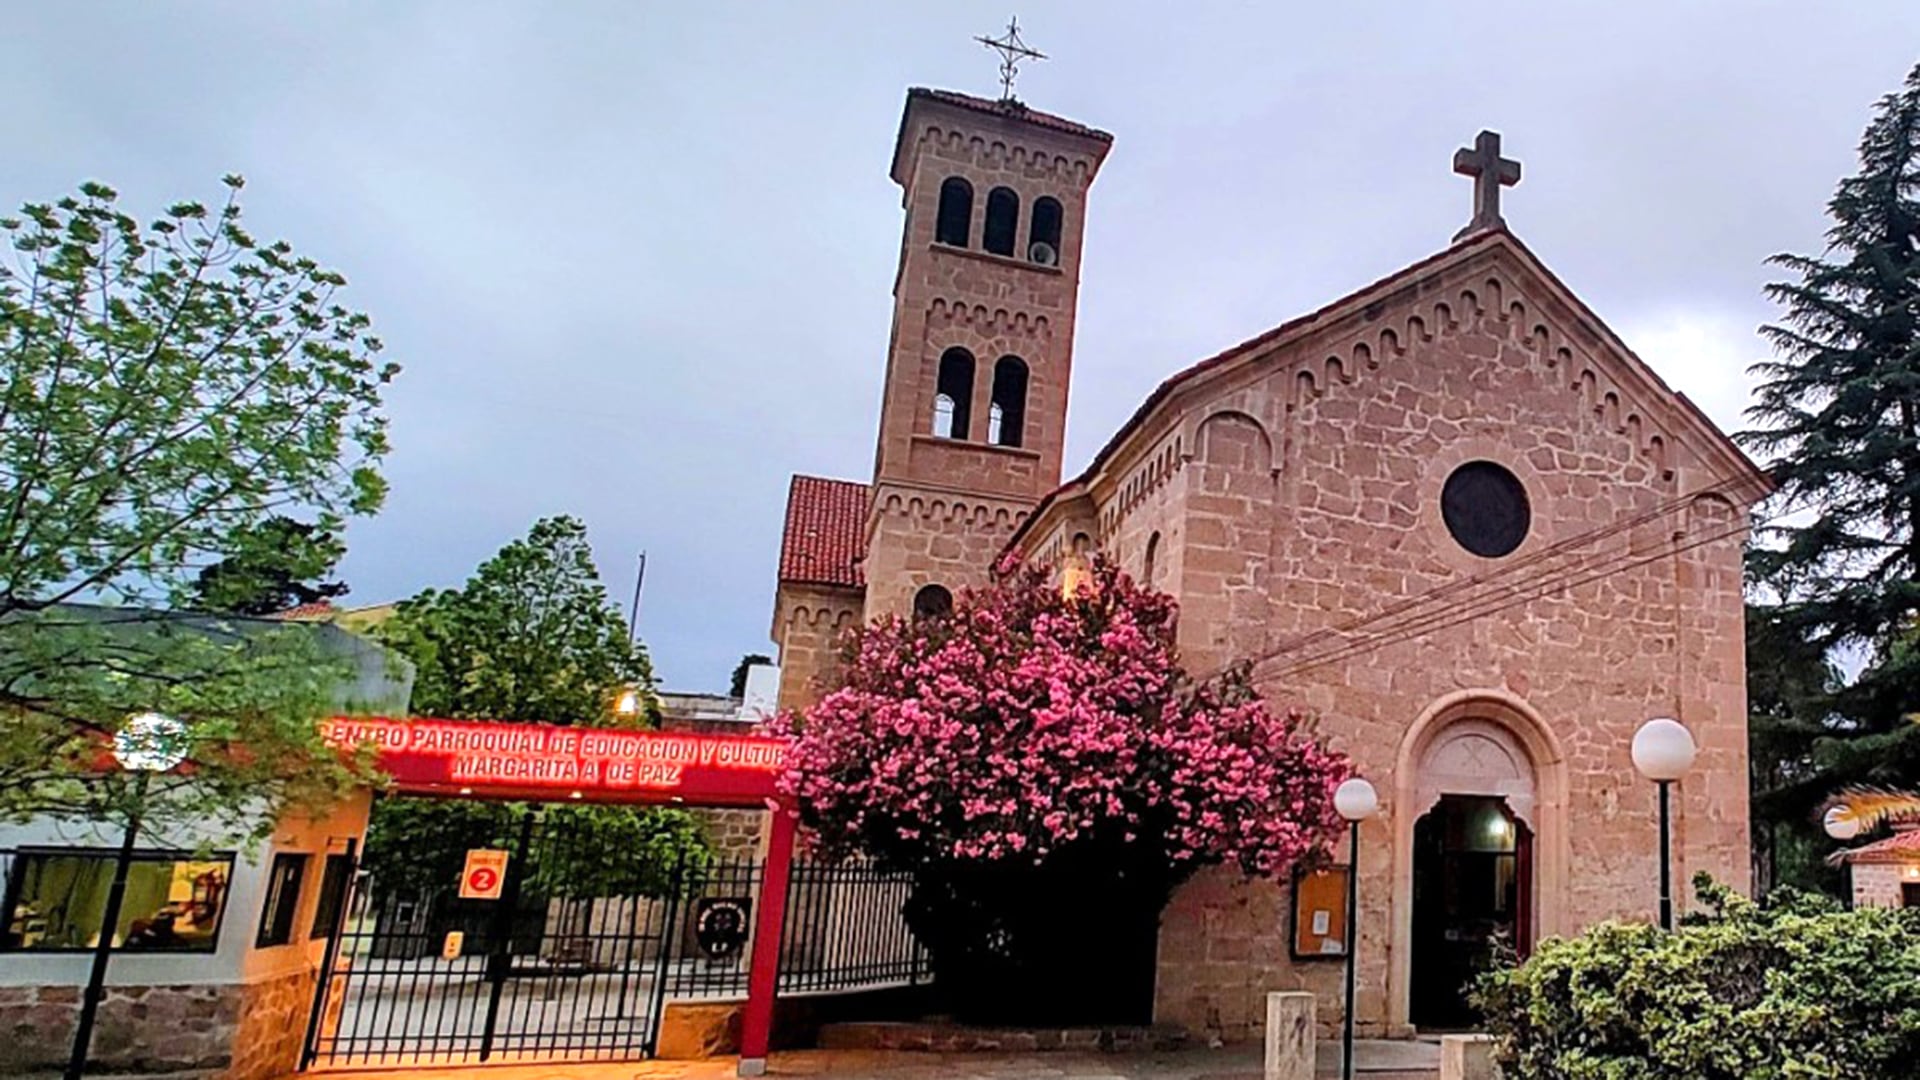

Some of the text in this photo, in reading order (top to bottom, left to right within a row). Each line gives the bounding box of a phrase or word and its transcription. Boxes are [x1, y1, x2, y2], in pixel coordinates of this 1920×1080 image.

[412, 728, 544, 753] PARROQUIAL
[551, 735, 577, 755] DE
[702, 741, 716, 762] Y
[453, 755, 577, 779] MARGARITA
[608, 762, 634, 781] DE
[640, 763, 680, 783] PAZ
[475, 871, 491, 889] 2
